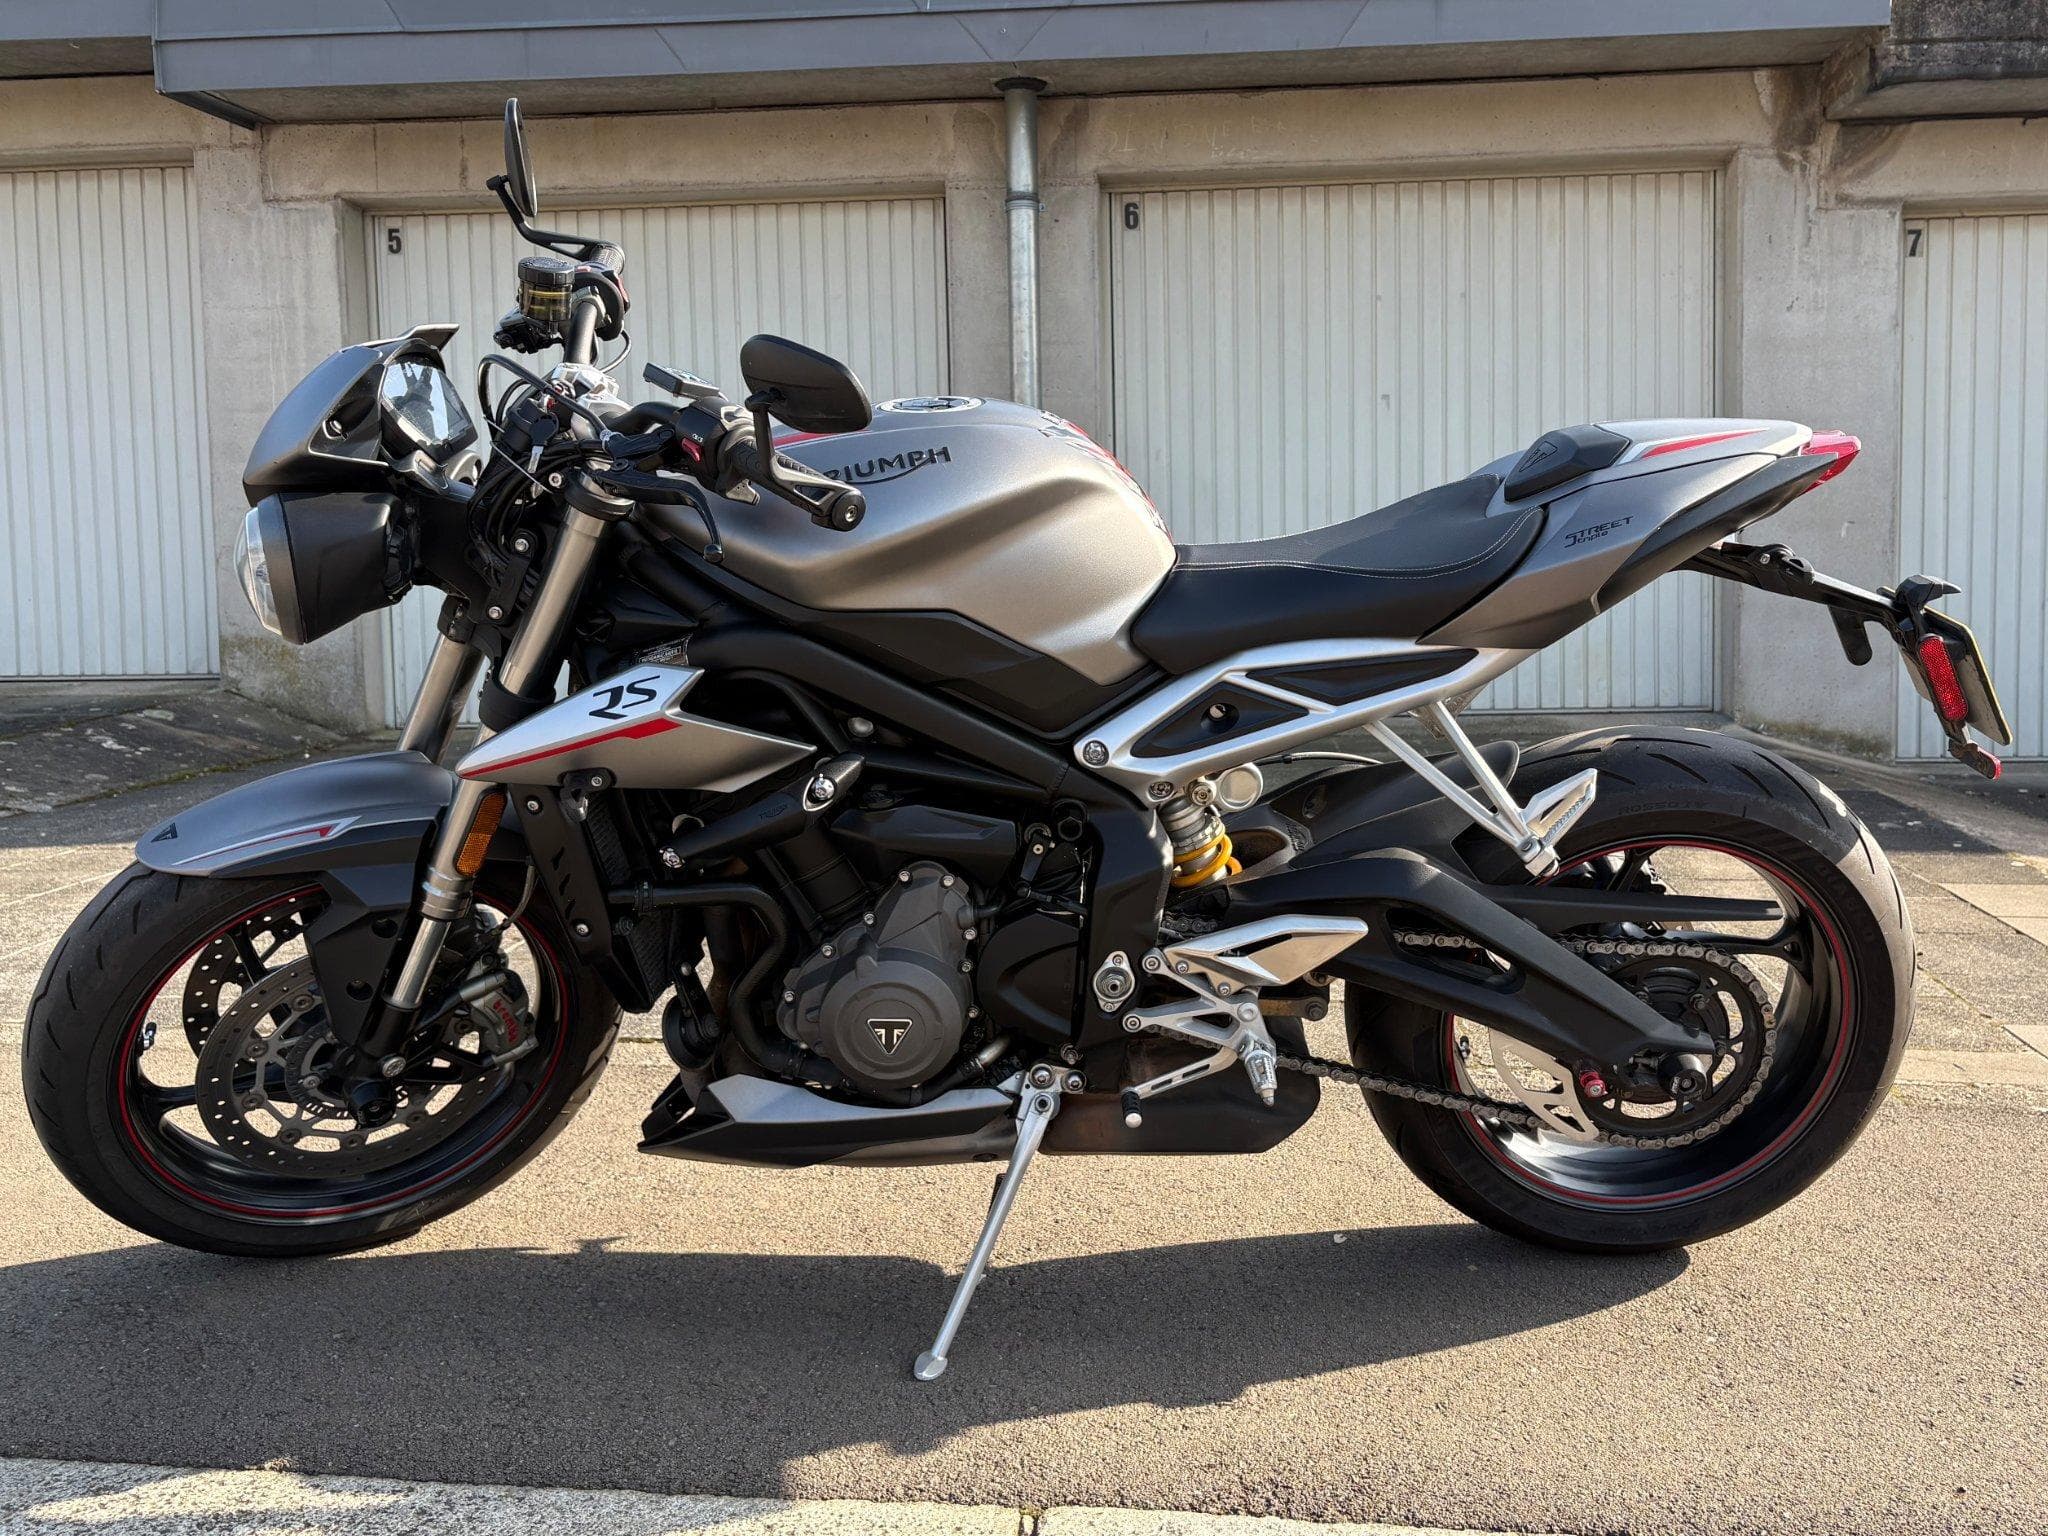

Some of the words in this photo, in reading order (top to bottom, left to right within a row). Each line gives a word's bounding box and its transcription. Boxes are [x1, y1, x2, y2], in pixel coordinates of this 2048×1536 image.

[1124, 202, 1139, 230] 6
[387, 228, 402, 254] 5
[1907, 229, 1922, 257] 7
[822, 446, 951, 483] RIUMPH
[1563, 515, 1634, 549] STREET
